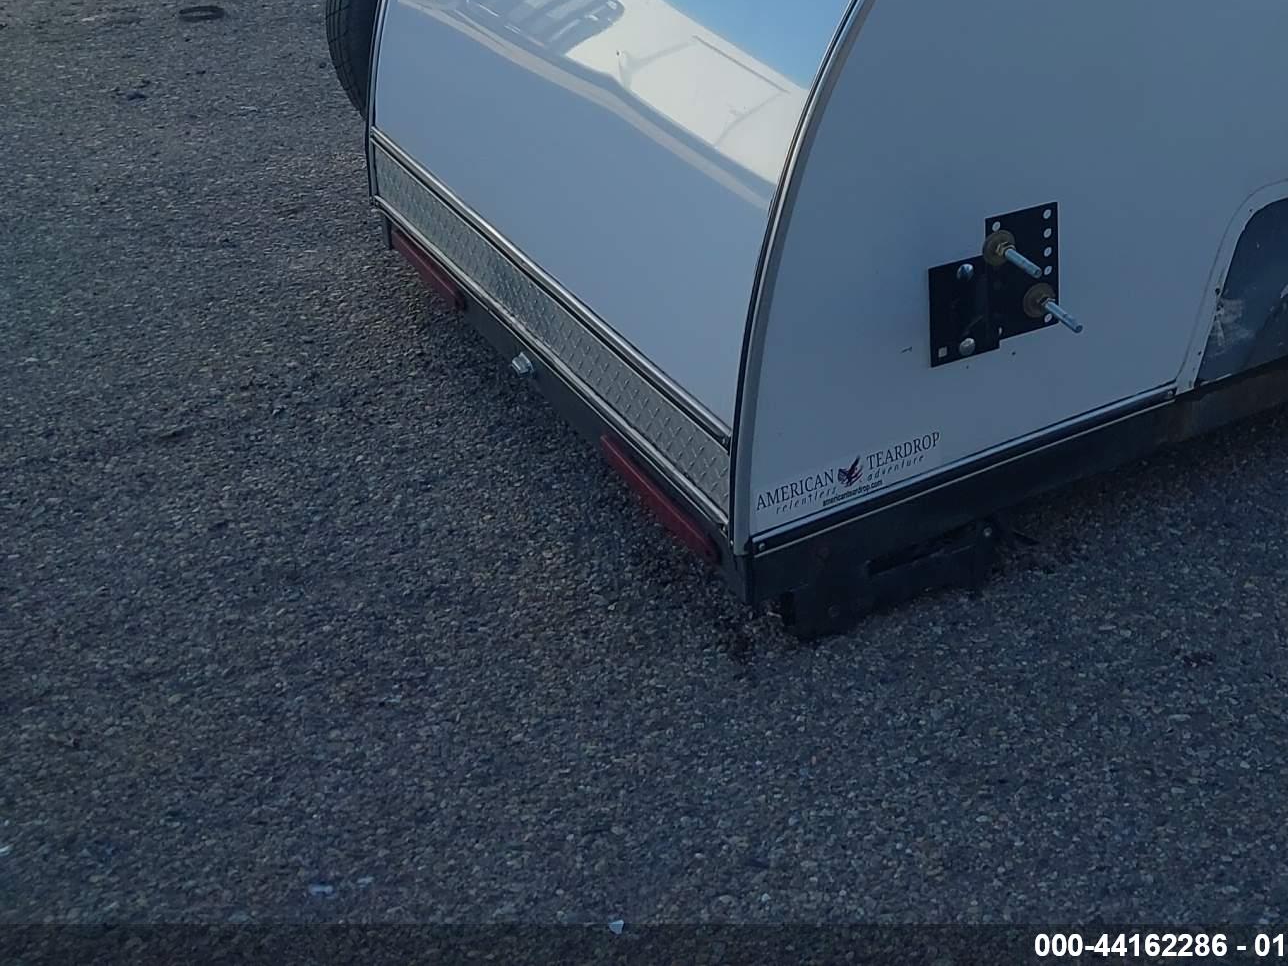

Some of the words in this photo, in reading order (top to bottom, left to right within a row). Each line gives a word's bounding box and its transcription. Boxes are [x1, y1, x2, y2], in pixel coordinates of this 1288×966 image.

[756, 468, 835, 511] AMERICAN
[866, 431, 940, 471] TEARDROP
[867, 454, 925, 482] adventure
